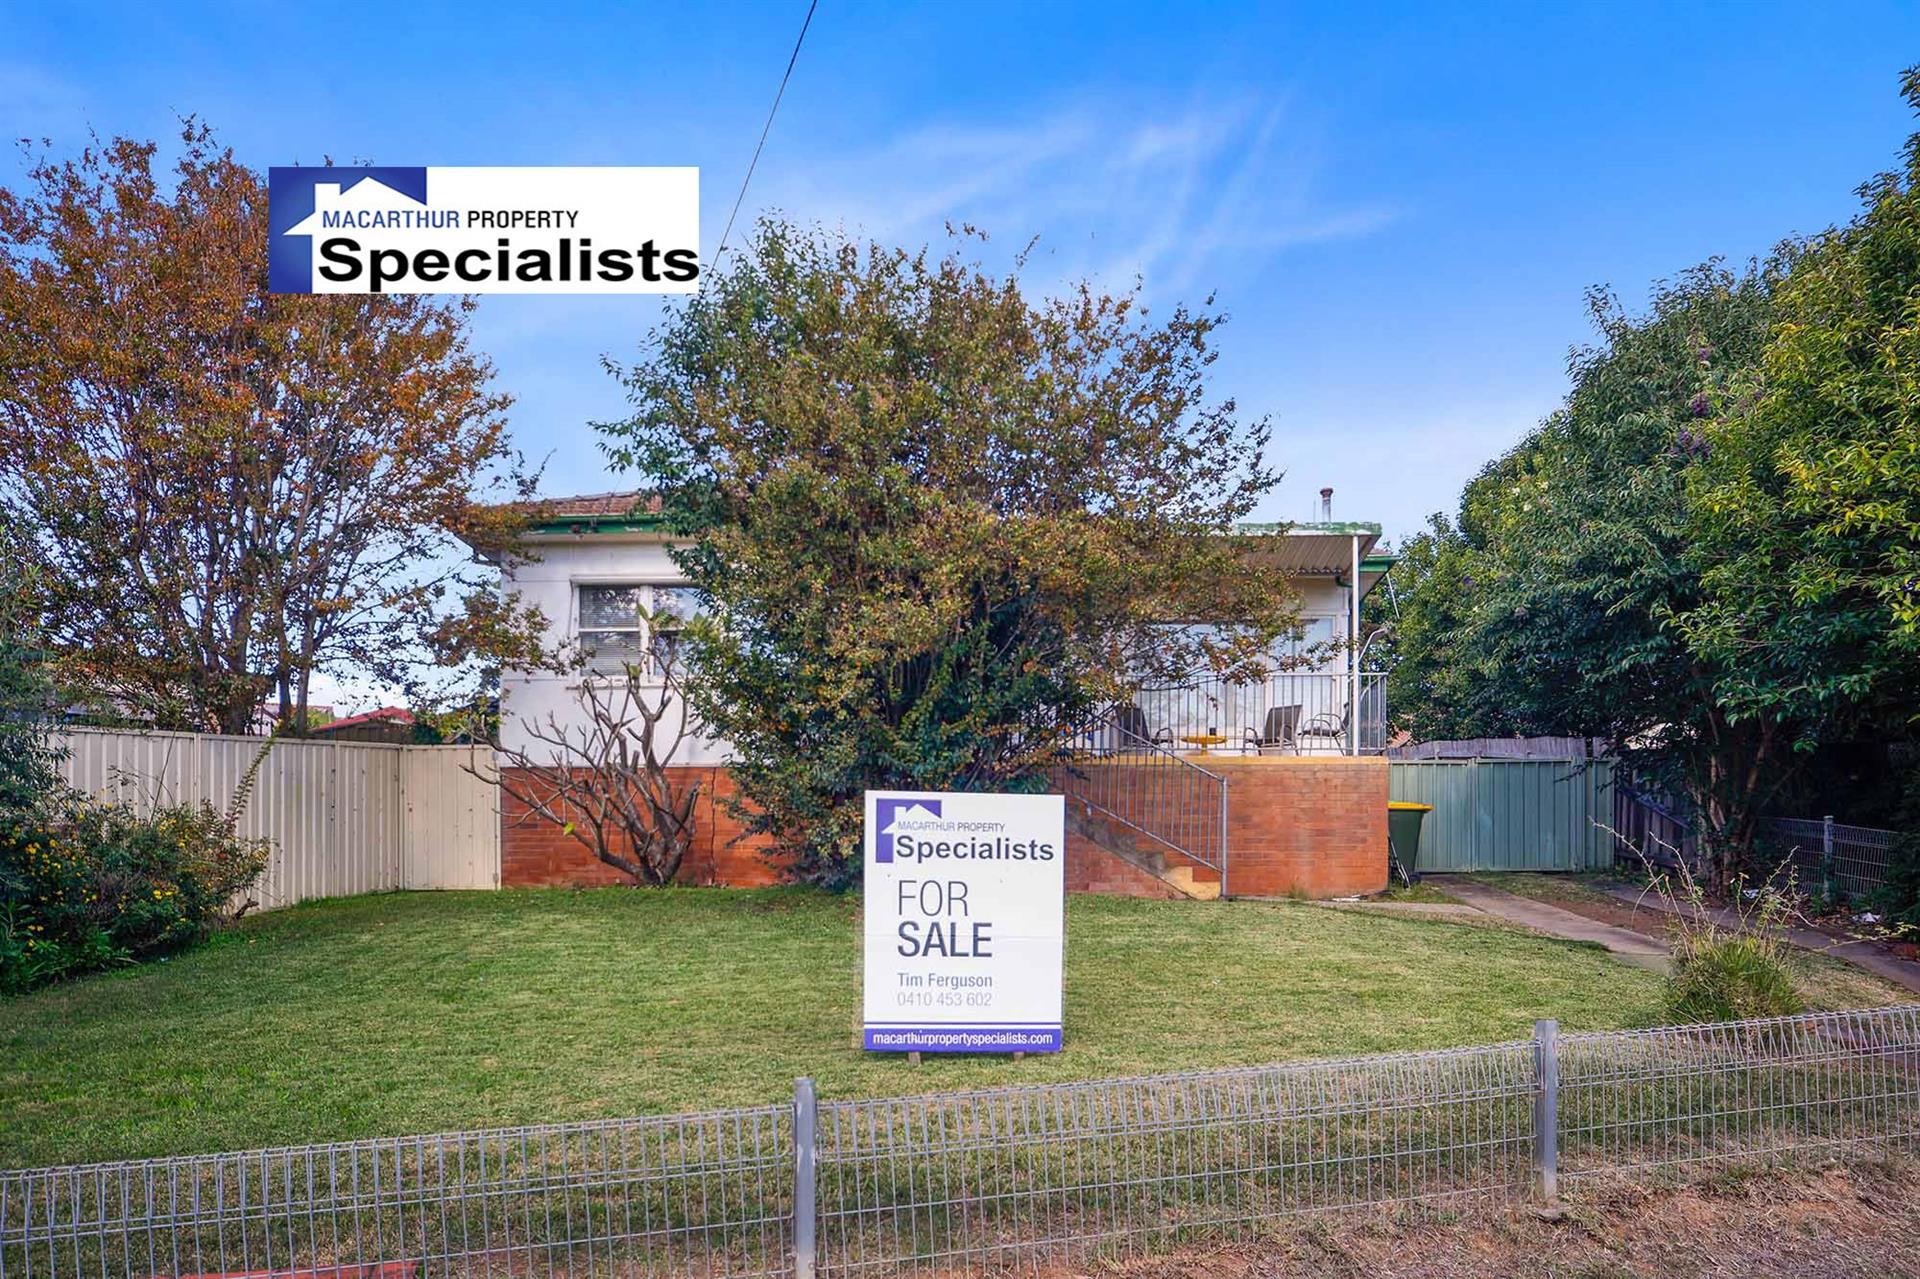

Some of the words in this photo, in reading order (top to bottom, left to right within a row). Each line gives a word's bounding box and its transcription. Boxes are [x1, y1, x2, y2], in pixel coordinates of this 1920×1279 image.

[898, 821, 955, 831] MACARTHUR
[957, 822, 1005, 832] PROPERTY
[896, 835, 1054, 864] Specialists
[898, 879, 968, 917] FOR
[897, 921, 993, 957] SALE
[897, 973, 923, 987] Tim
[928, 973, 993, 990] Ferguson
[897, 992, 931, 1006] 0410
[936, 992, 962, 1006] 453
[966, 992, 992, 1006] 602
[873, 1031, 1053, 1046] macarthurpropertyspecialists.com
